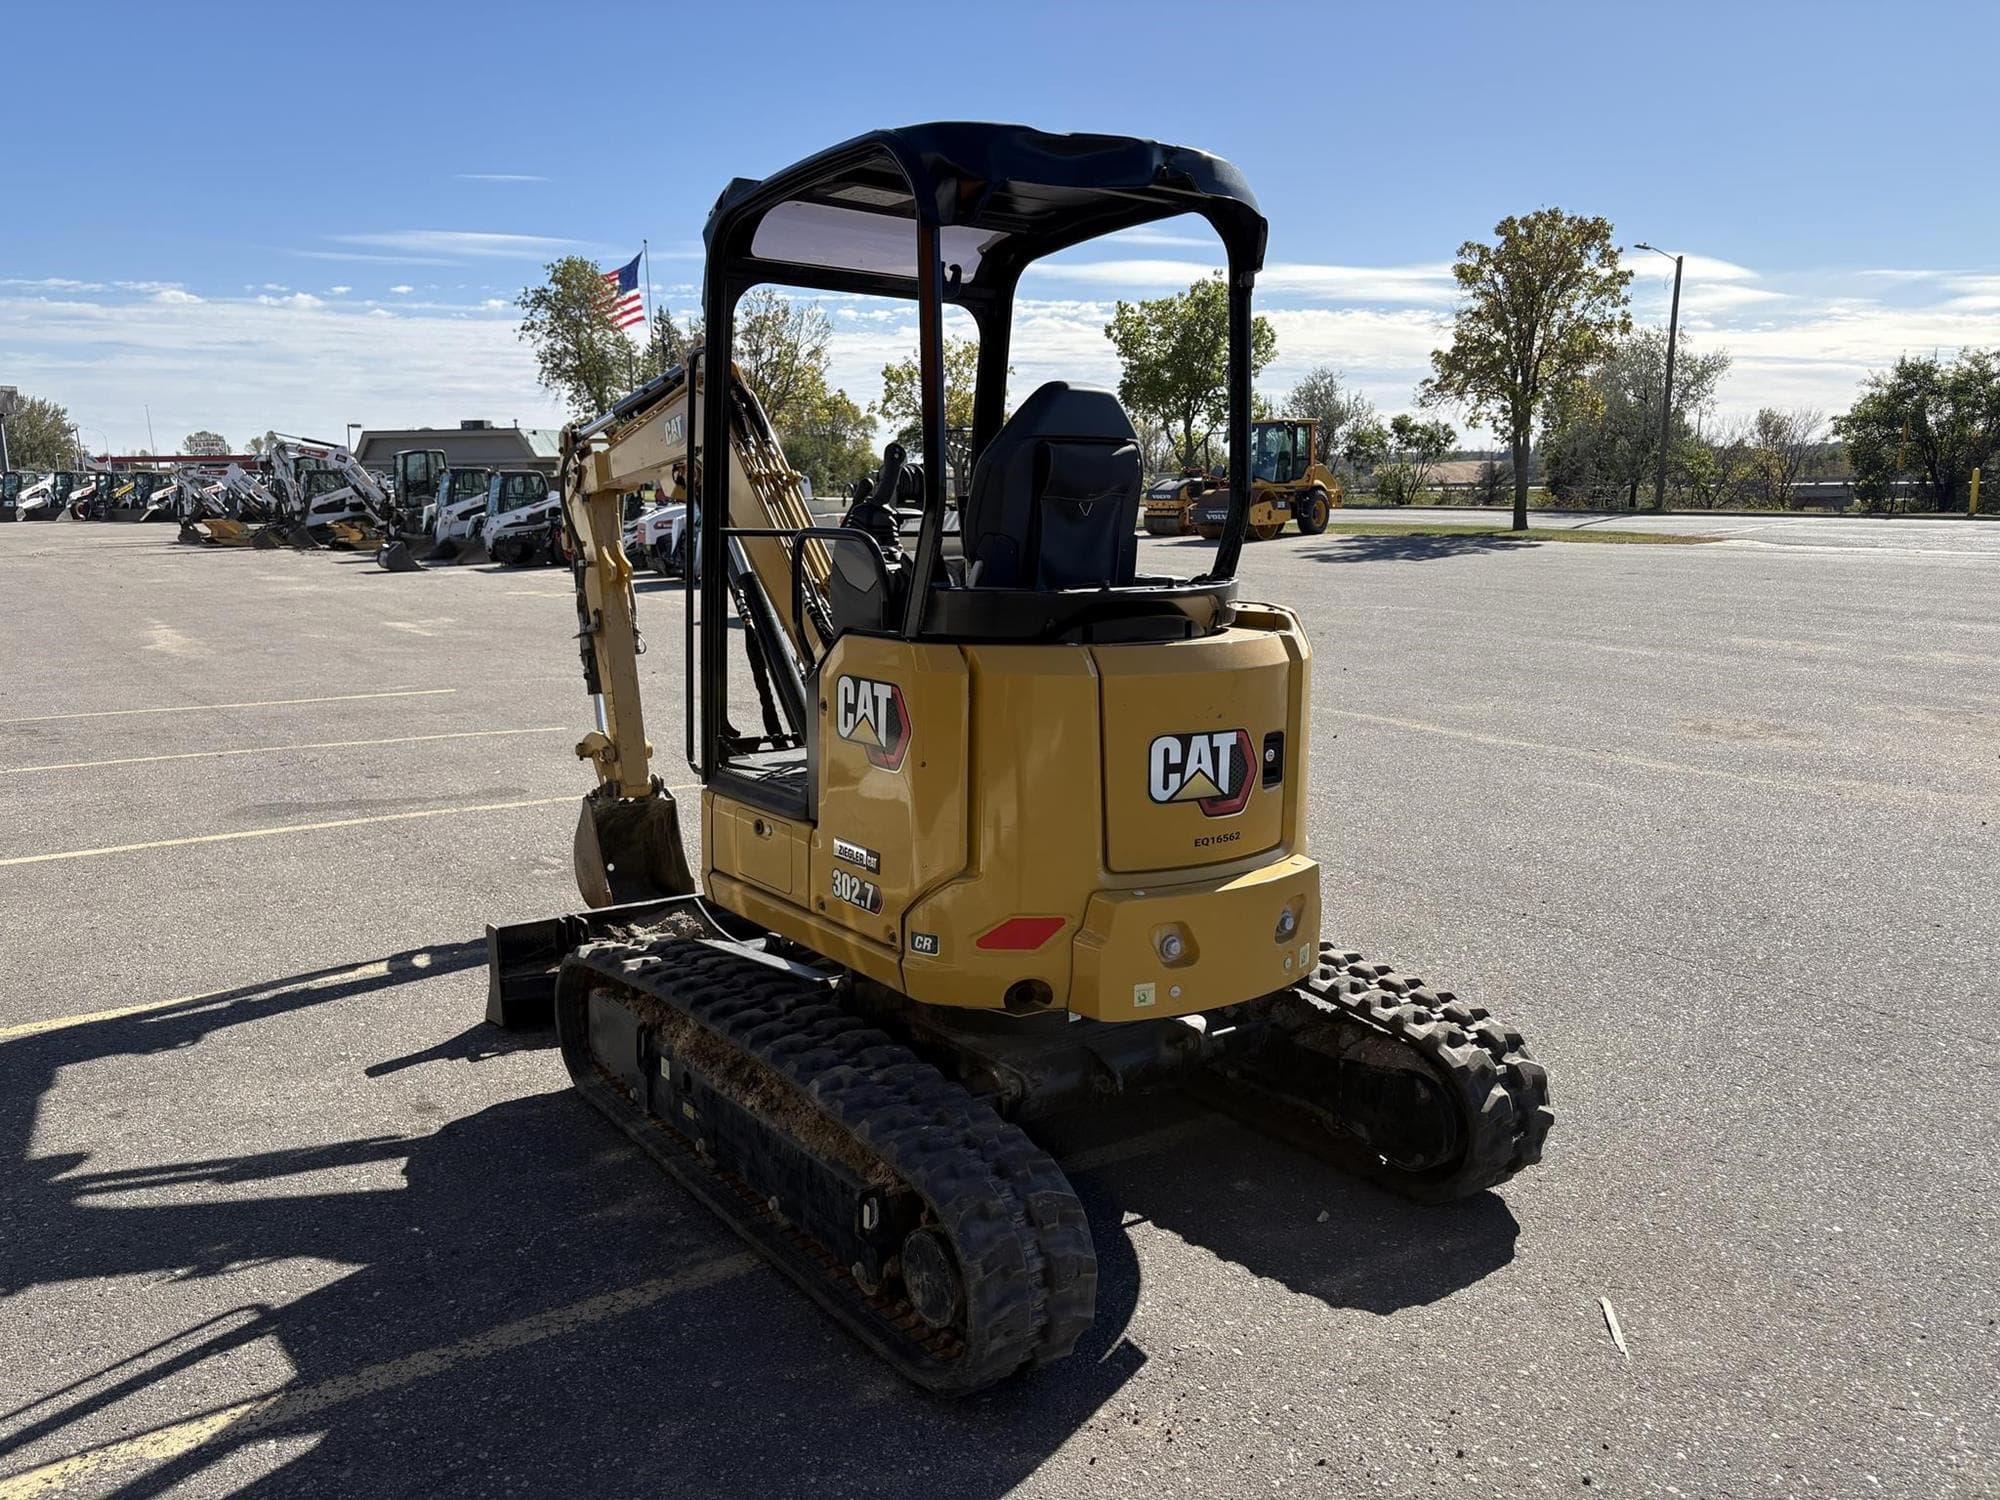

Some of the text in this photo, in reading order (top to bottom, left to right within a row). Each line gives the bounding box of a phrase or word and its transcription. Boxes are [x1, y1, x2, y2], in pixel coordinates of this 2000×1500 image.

[664, 414, 682, 446] CAT
[837, 675, 892, 748] CAT
[1150, 731, 1238, 802] CAT
[1194, 831, 1241, 847] EQ16562
[838, 844, 878, 868] ZIEGLER CAT
[832, 868, 875, 910] 302.7
[914, 935, 933, 951] CR
